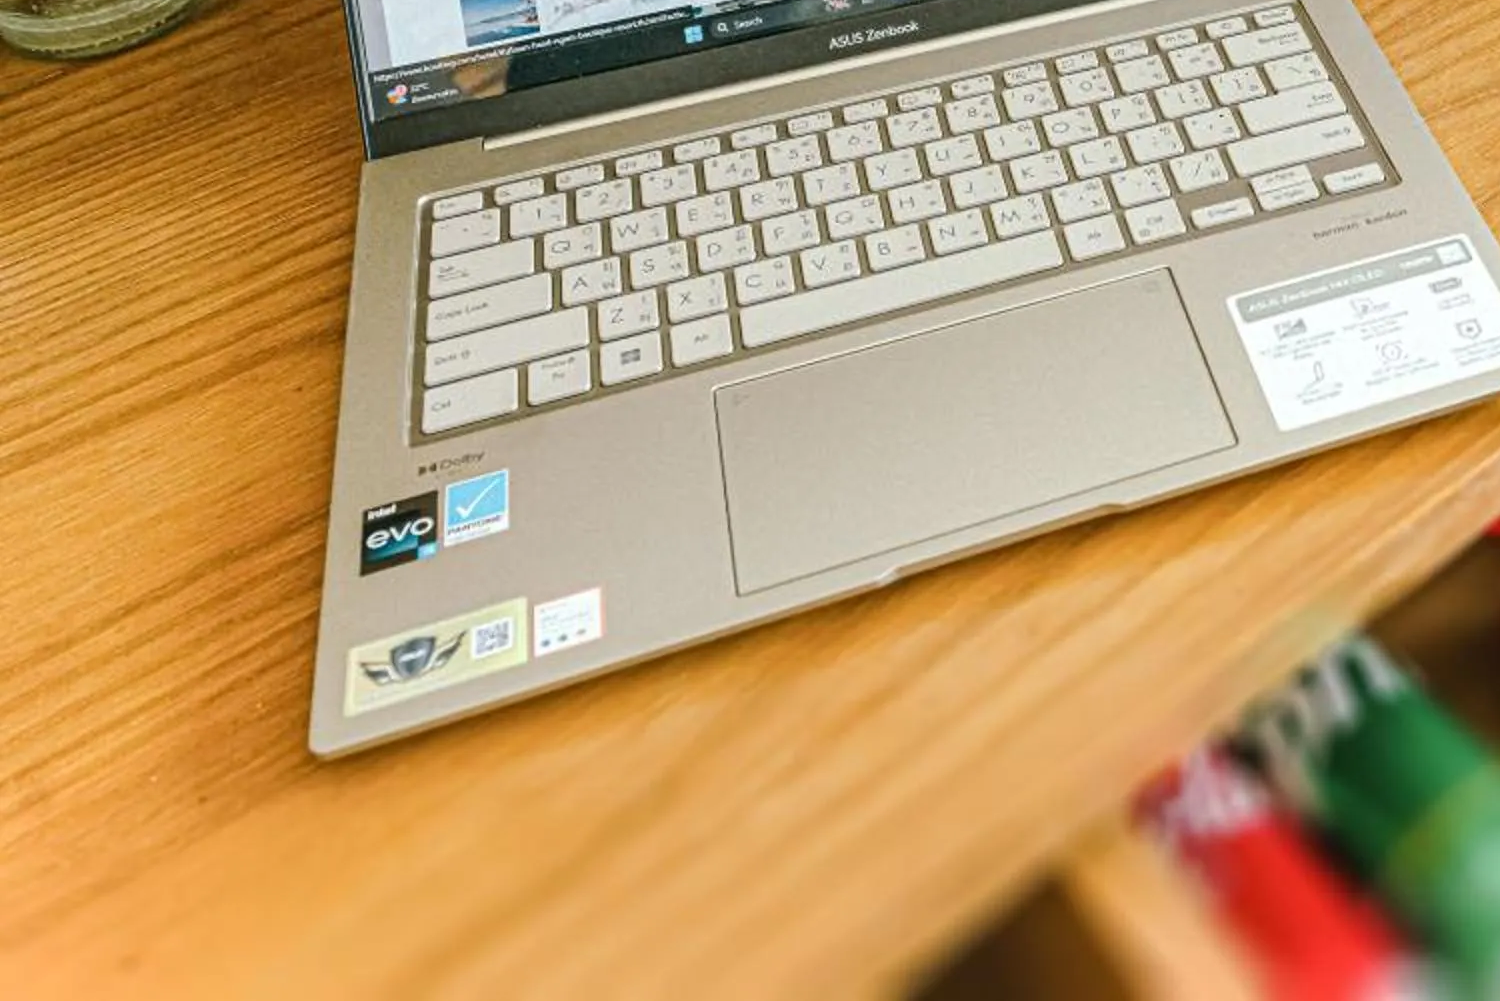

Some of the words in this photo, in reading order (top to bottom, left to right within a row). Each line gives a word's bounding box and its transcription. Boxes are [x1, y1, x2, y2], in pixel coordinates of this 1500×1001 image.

[828, 32, 863, 50] ASUS
[864, 20, 921, 41] Zenbook
[617, 222, 640, 239] W
[573, 276, 588, 291] A
[642, 257, 655, 274] S
[706, 242, 722, 258] D
[610, 307, 624, 324] Z
[744, 272, 764, 289] C
[812, 255, 827, 271] V
[877, 242, 892, 256] B
[939, 226, 956, 240] N
[1000, 210, 1022, 224] M
[439, 451, 487, 470] Dolby
[365, 516, 435, 550] evo
